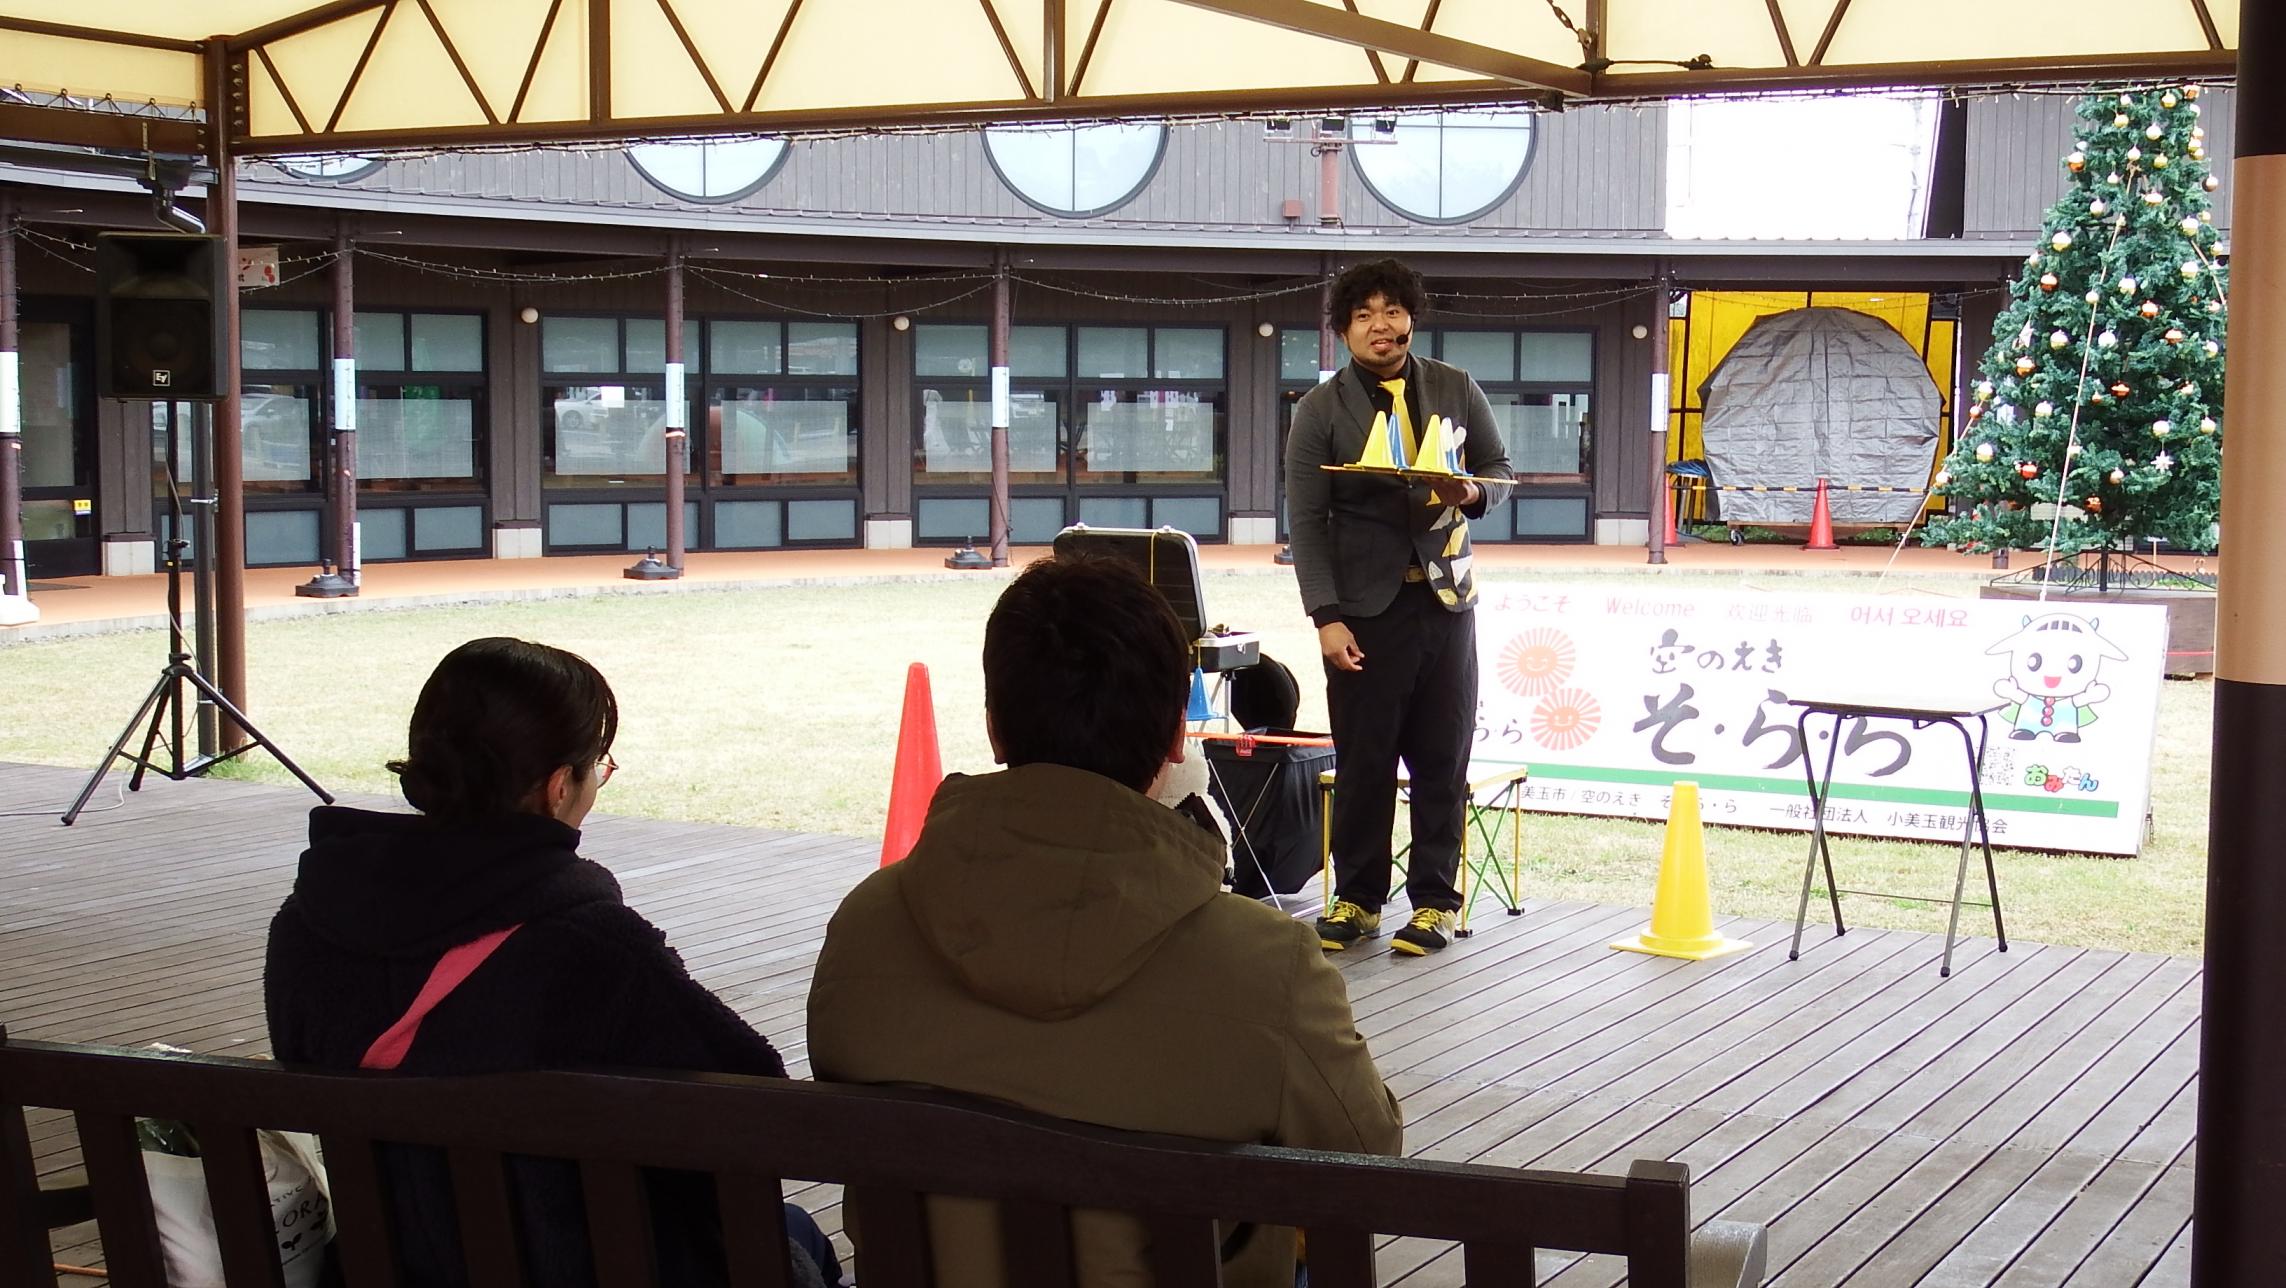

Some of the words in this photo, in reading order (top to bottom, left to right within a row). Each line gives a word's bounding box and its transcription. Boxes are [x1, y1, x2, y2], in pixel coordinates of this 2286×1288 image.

[1495, 594, 1572, 614] ようこそ
[1606, 597, 1696, 618] Welcome
[1850, 606, 1895, 627] 어서
[1901, 607, 1969, 629] 오세요
[1650, 628, 1784, 675] 空のえき
[1632, 682, 1913, 777] そ・ら・ら
[2023, 764, 2100, 793] おみたん
[1769, 803, 1869, 825] 一般社団法人
